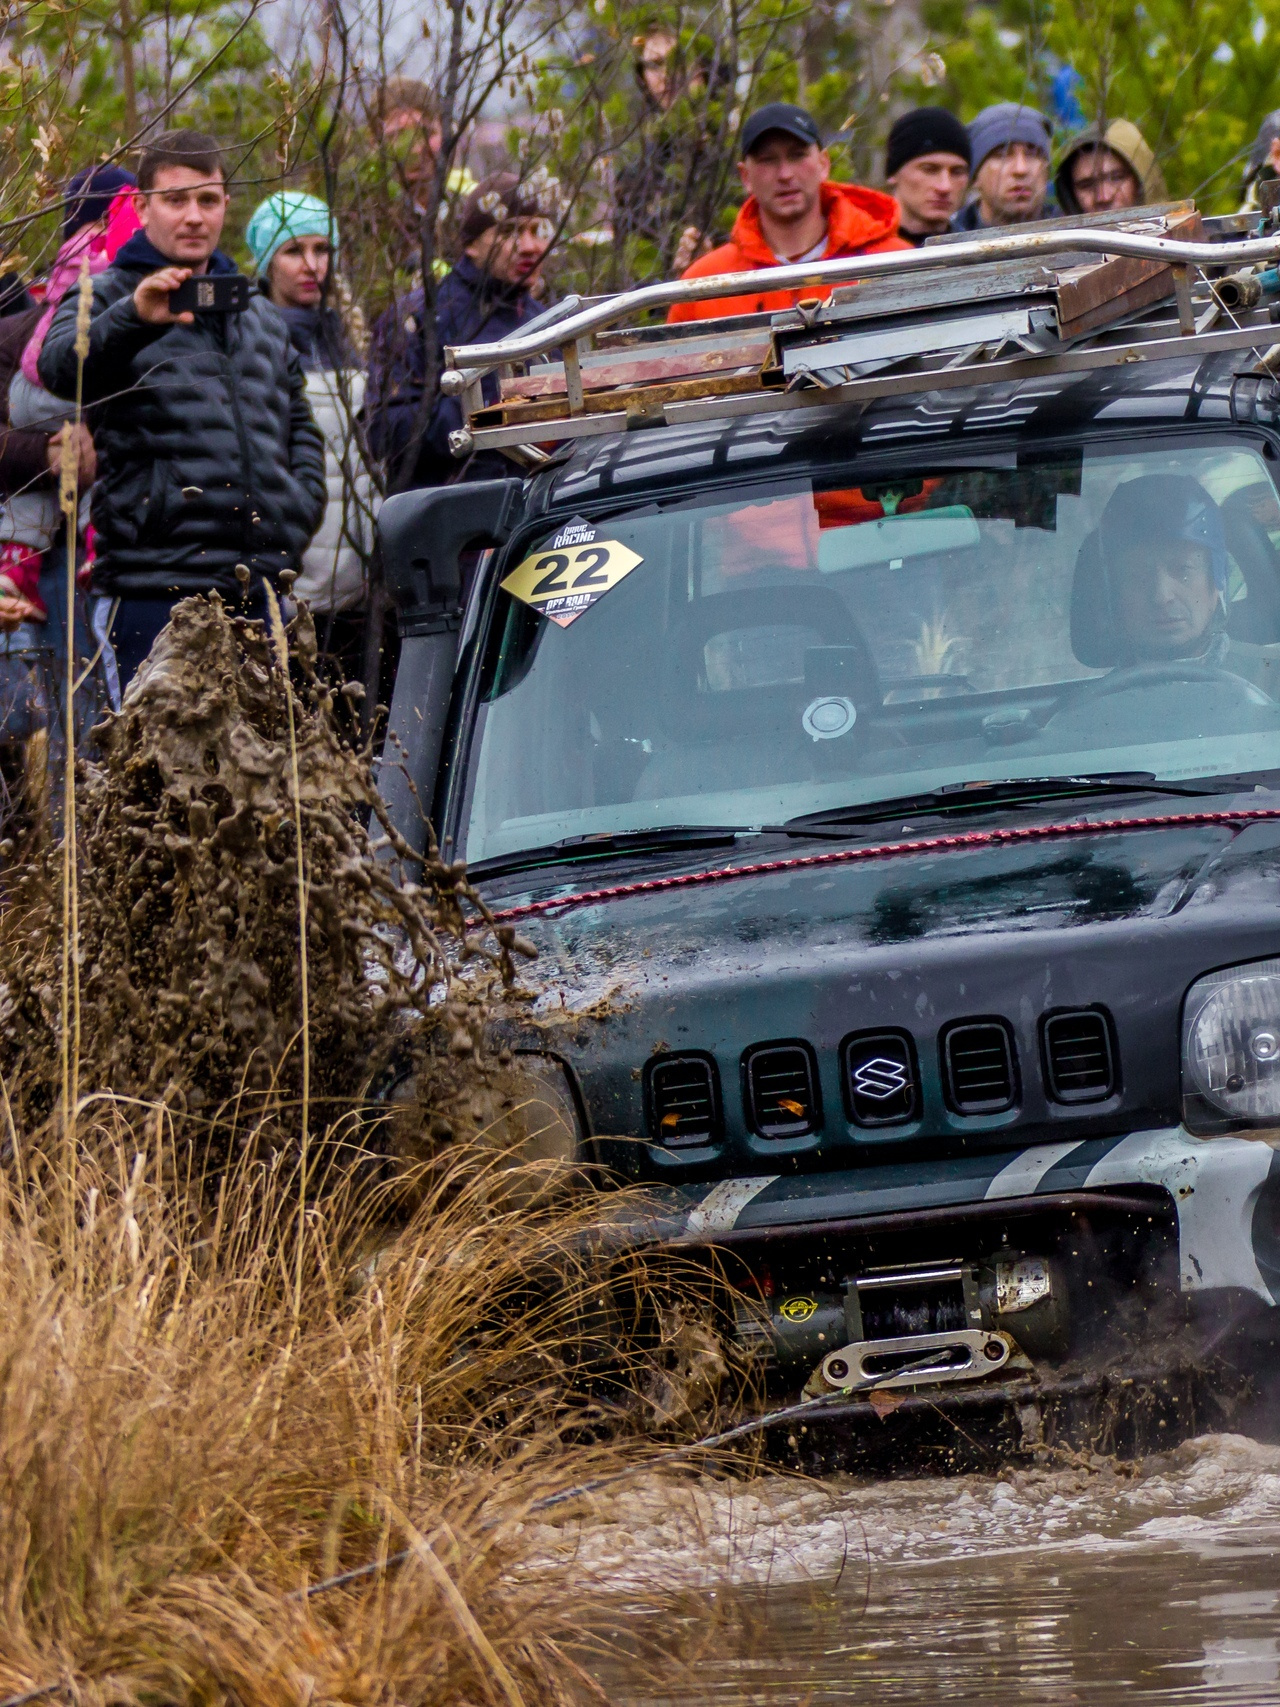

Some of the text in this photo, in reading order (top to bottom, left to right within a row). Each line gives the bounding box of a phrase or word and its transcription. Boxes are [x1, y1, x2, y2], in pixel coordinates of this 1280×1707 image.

[565, 524, 588, 535] DRIVE
[553, 530, 596, 549] RACING
[531, 548, 610, 596] 22
[546, 593, 591, 611] OFF ROAD
